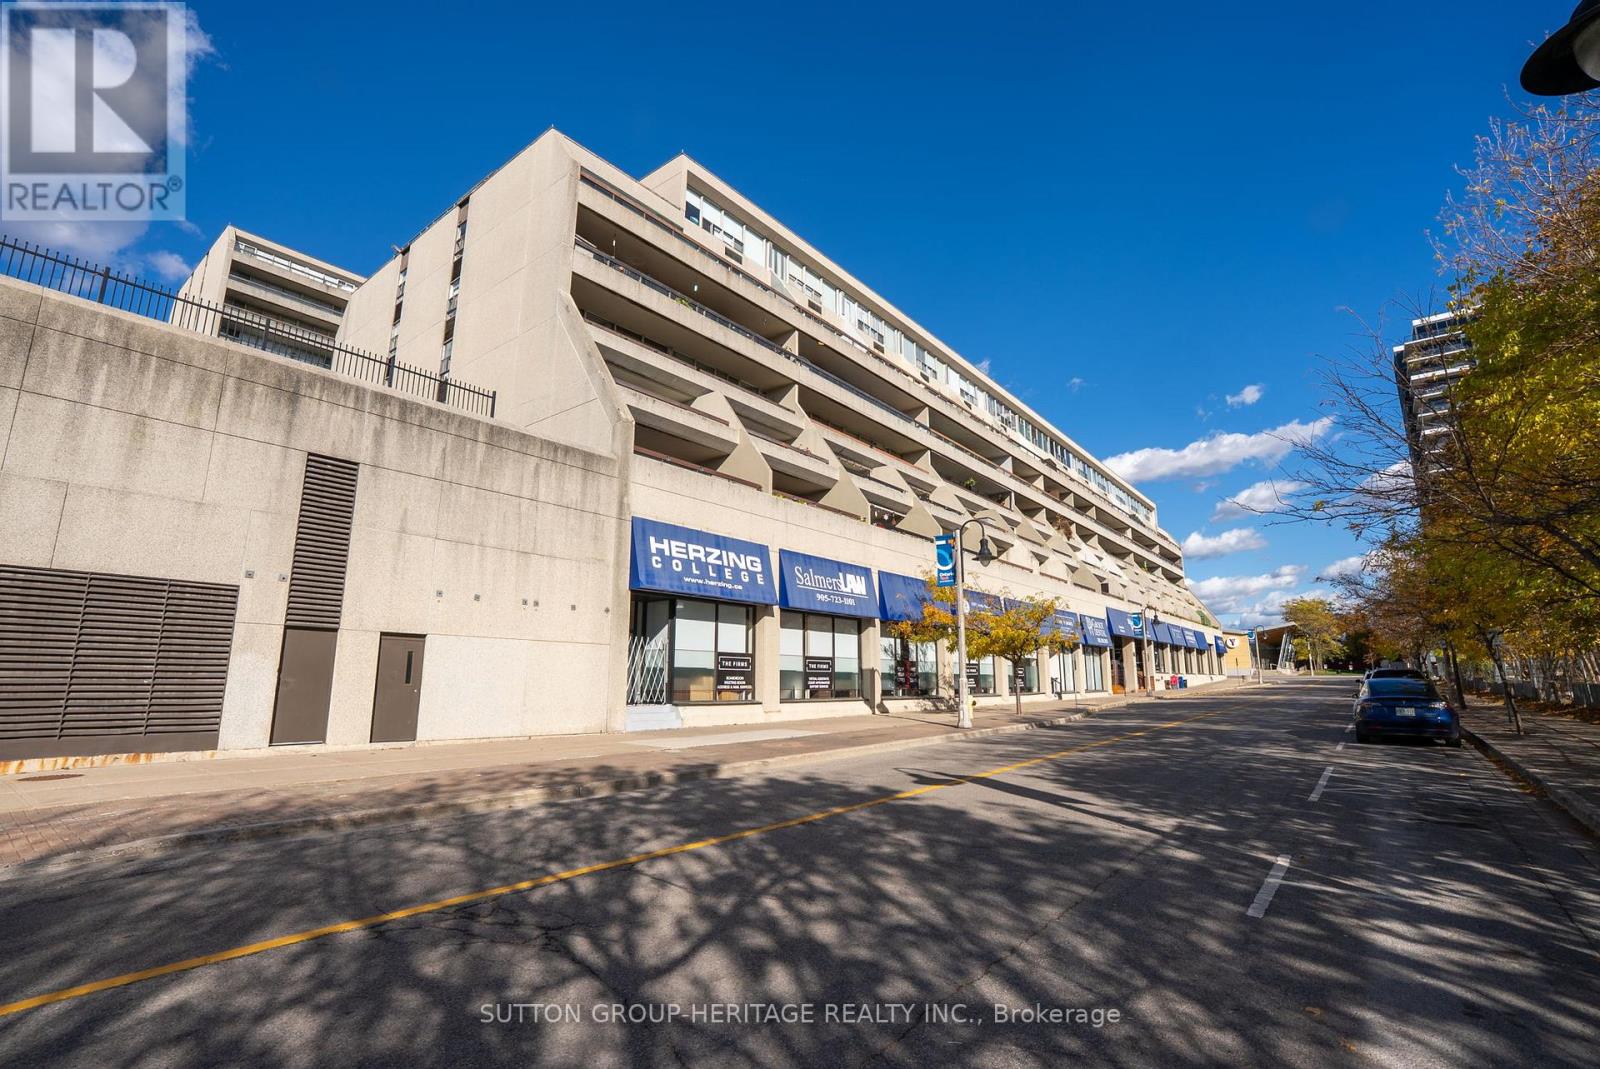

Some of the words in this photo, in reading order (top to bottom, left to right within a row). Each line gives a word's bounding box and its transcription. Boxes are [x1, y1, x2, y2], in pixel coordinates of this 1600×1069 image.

[649, 536, 762, 572] HERZING
[651, 556, 764, 585] COLLEGE
[683, 576, 743, 590] www.herzing.ca
